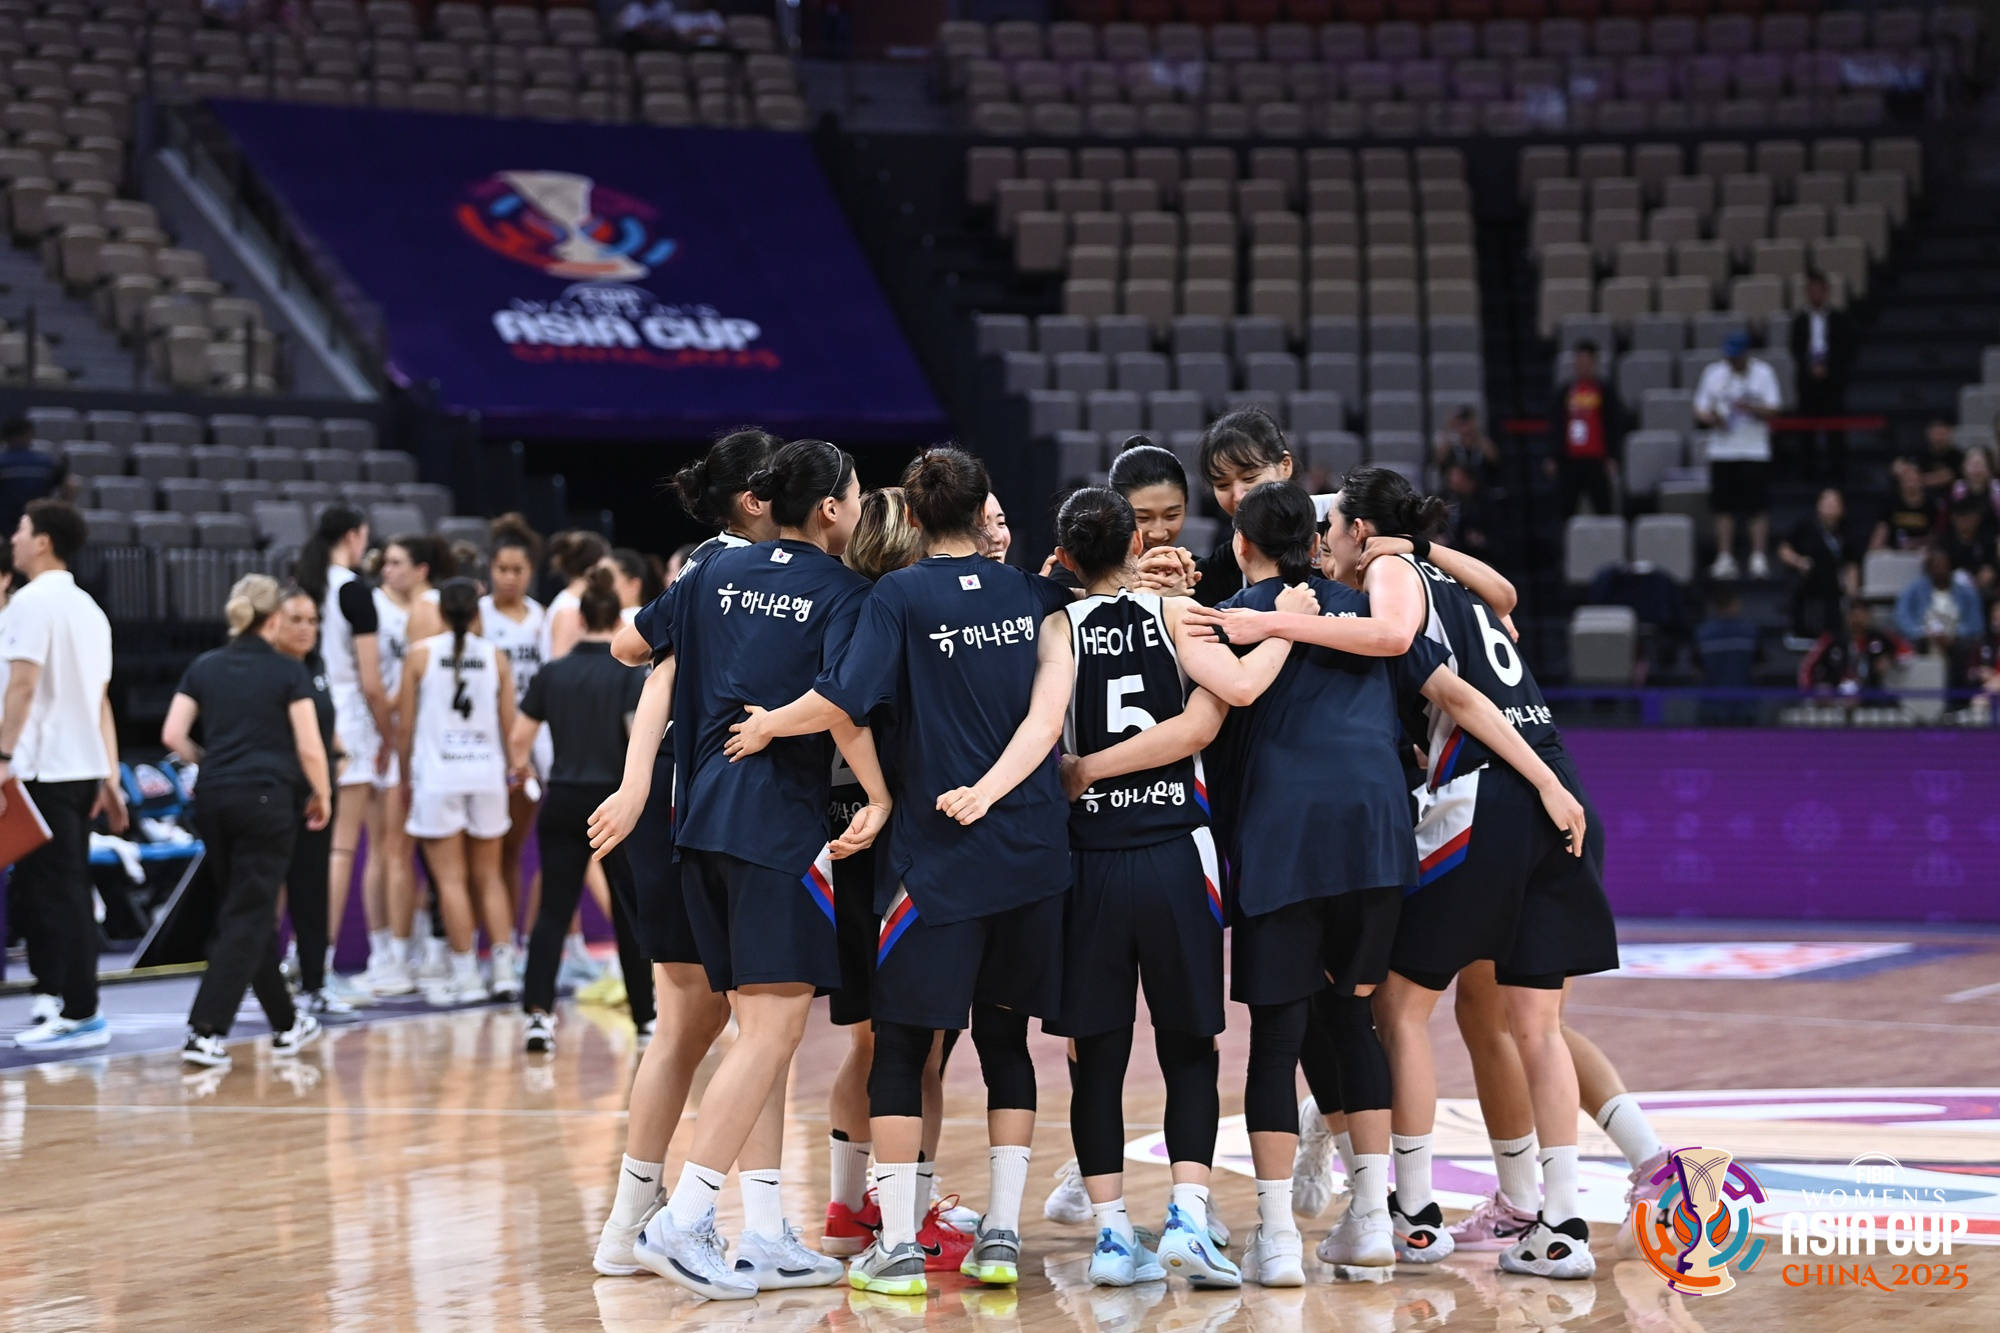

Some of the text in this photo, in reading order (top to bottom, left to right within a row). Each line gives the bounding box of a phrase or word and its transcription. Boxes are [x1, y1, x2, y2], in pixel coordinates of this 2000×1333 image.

[642, 316, 761, 351] CUP
[741, 590, 813, 622] 하나은행
[962, 616, 1034, 649] 하나은행
[1472, 604, 1523, 687] 6
[453, 681, 472, 720] 4
[1107, 674, 1157, 733] 5
[1109, 780, 1185, 807] 하나은행
